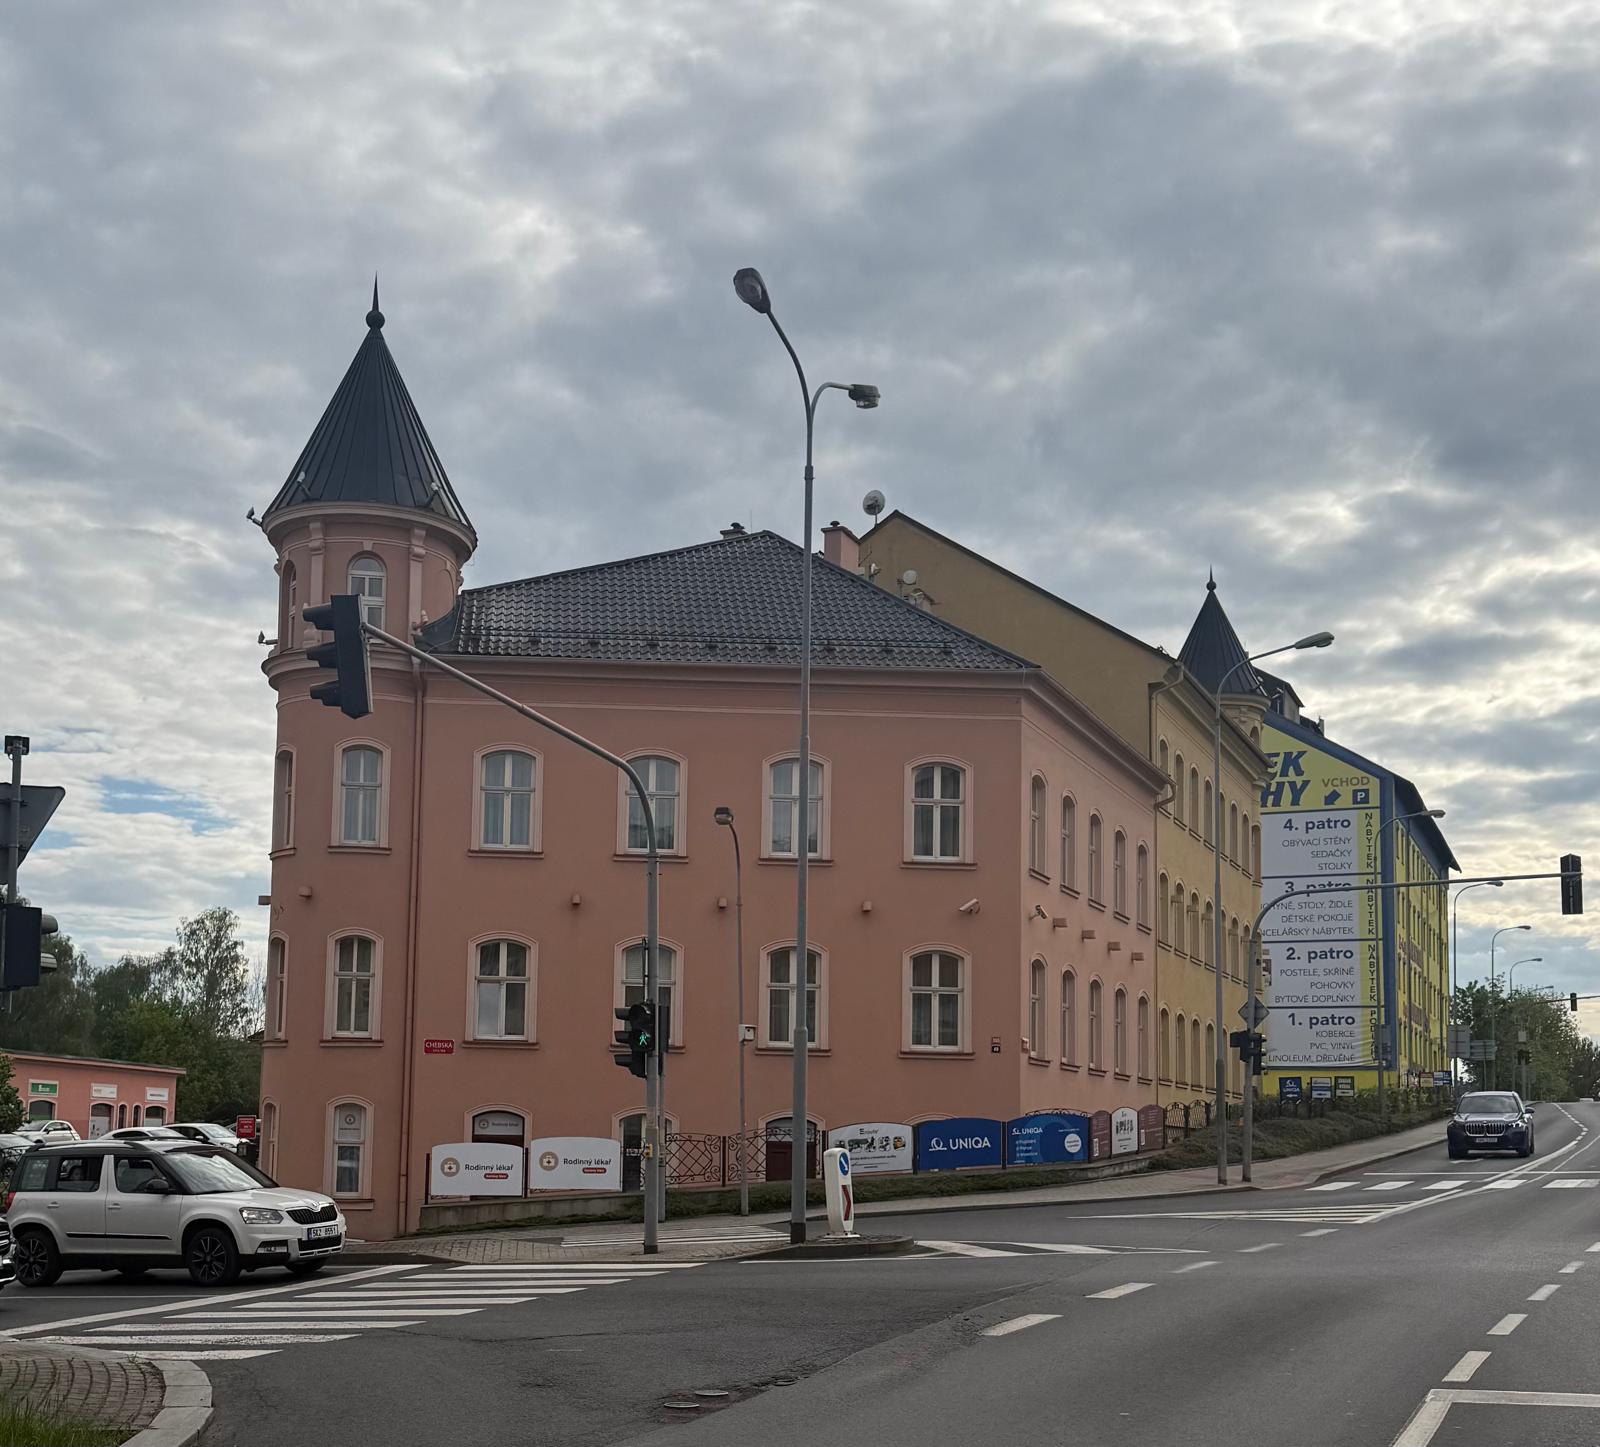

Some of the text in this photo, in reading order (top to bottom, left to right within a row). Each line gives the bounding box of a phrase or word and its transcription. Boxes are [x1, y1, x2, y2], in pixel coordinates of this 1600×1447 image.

[1321, 777, 1370, 788] VCHOD
[1261, 780, 1311, 808] HY
[1283, 817, 1351, 834] 4. patro
[1323, 836, 1352, 846] STĚNY
[1311, 848, 1352, 858] SEDAČKY
[1318, 862, 1352, 871] STOLKY
[1285, 881, 1297, 893] 3
[1328, 900, 1353, 909] ŽIDLE
[1281, 913, 1353, 923] DĚTSKÉ POKOJE
[1312, 926, 1354, 935] NÁBYTEK
[1286, 947, 1354, 963] 2. patro
[1310, 981, 1355, 990] POHOVKY
[1275, 993, 1355, 1003] BYTOVÉ DOPLŇKY
[1288, 1013, 1355, 1030] 1. patro
[1315, 1030, 1355, 1038] KOBERCE
[1330, 1042, 1355, 1050] VINYL
[1021, 1127, 1043, 1135] UNIQA
[949, 1136, 991, 1149] UNIQA
[563, 1157, 612, 1166] Rodinný lékař
[464, 1163, 514, 1172] Rodinný lékař
